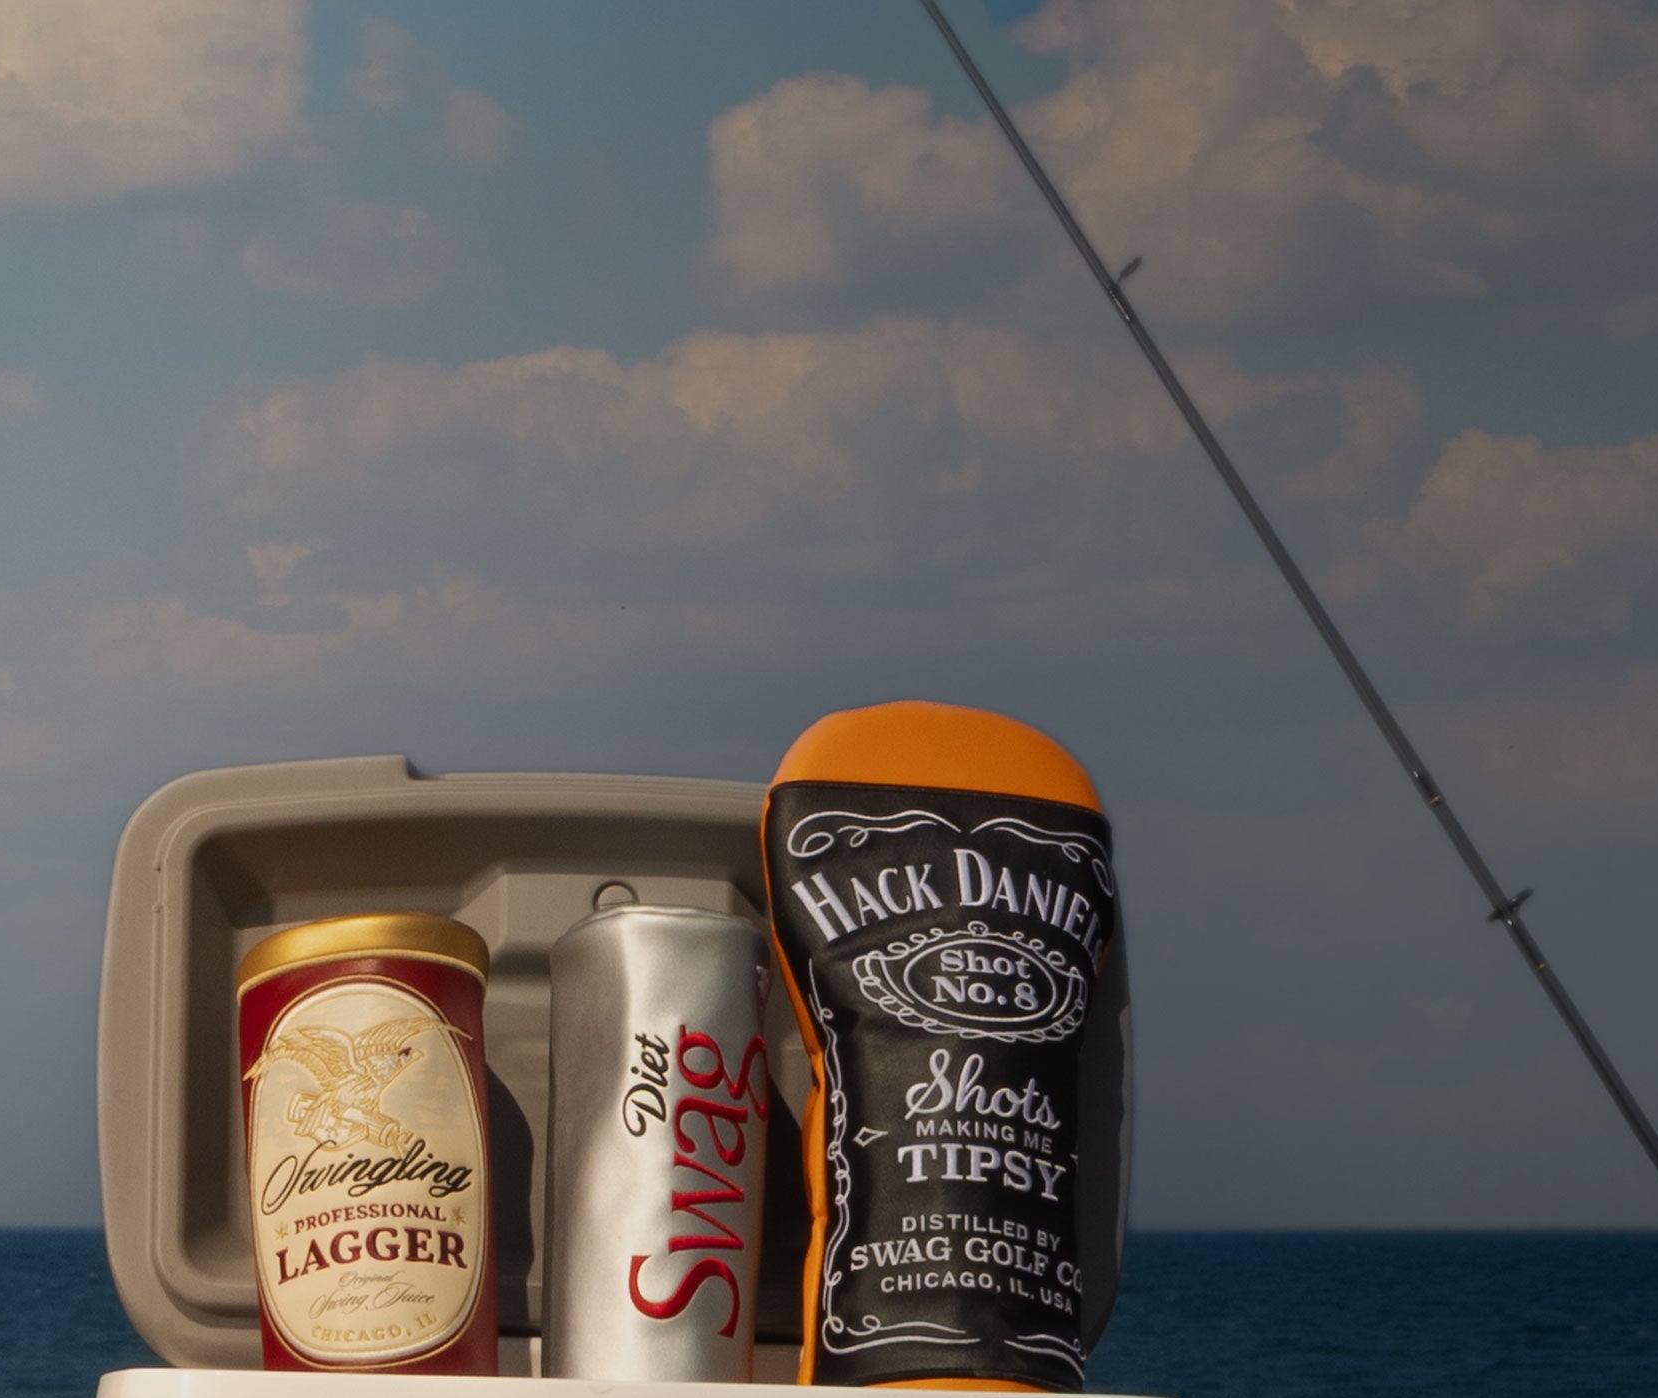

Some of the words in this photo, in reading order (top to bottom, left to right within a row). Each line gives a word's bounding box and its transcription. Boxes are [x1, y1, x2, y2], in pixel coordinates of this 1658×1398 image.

[791, 863, 943, 943] HACK
[940, 949, 1031, 979] Shot
[930, 975, 1007, 1006] No.
[1014, 982, 1039, 1010] 8
[622, 1030, 670, 1138] Diet
[904, 1049, 1061, 1130] Shots
[916, 1119, 1015, 1142] MAKING
[1024, 1130, 1053, 1155] ME
[260, 1139, 474, 1216] Swingling
[628, 1024, 769, 1339] Swag
[897, 1143, 1067, 1202] TIPSY
[294, 1203, 447, 1235] PROFESSIONAL
[901, 1213, 1029, 1240] DISTILLED
[1036, 1229, 1061, 1251] BY
[275, 1226, 468, 1286] LAGGER
[850, 1236, 952, 1272] SWAG
[964, 1236, 1049, 1277] GOLF
[308, 1288, 370, 1319] Swing
[364, 1281, 437, 1311] Juice
[880, 1271, 1001, 1293] CHICAGO,
[1040, 1287, 1073, 1316] USA
